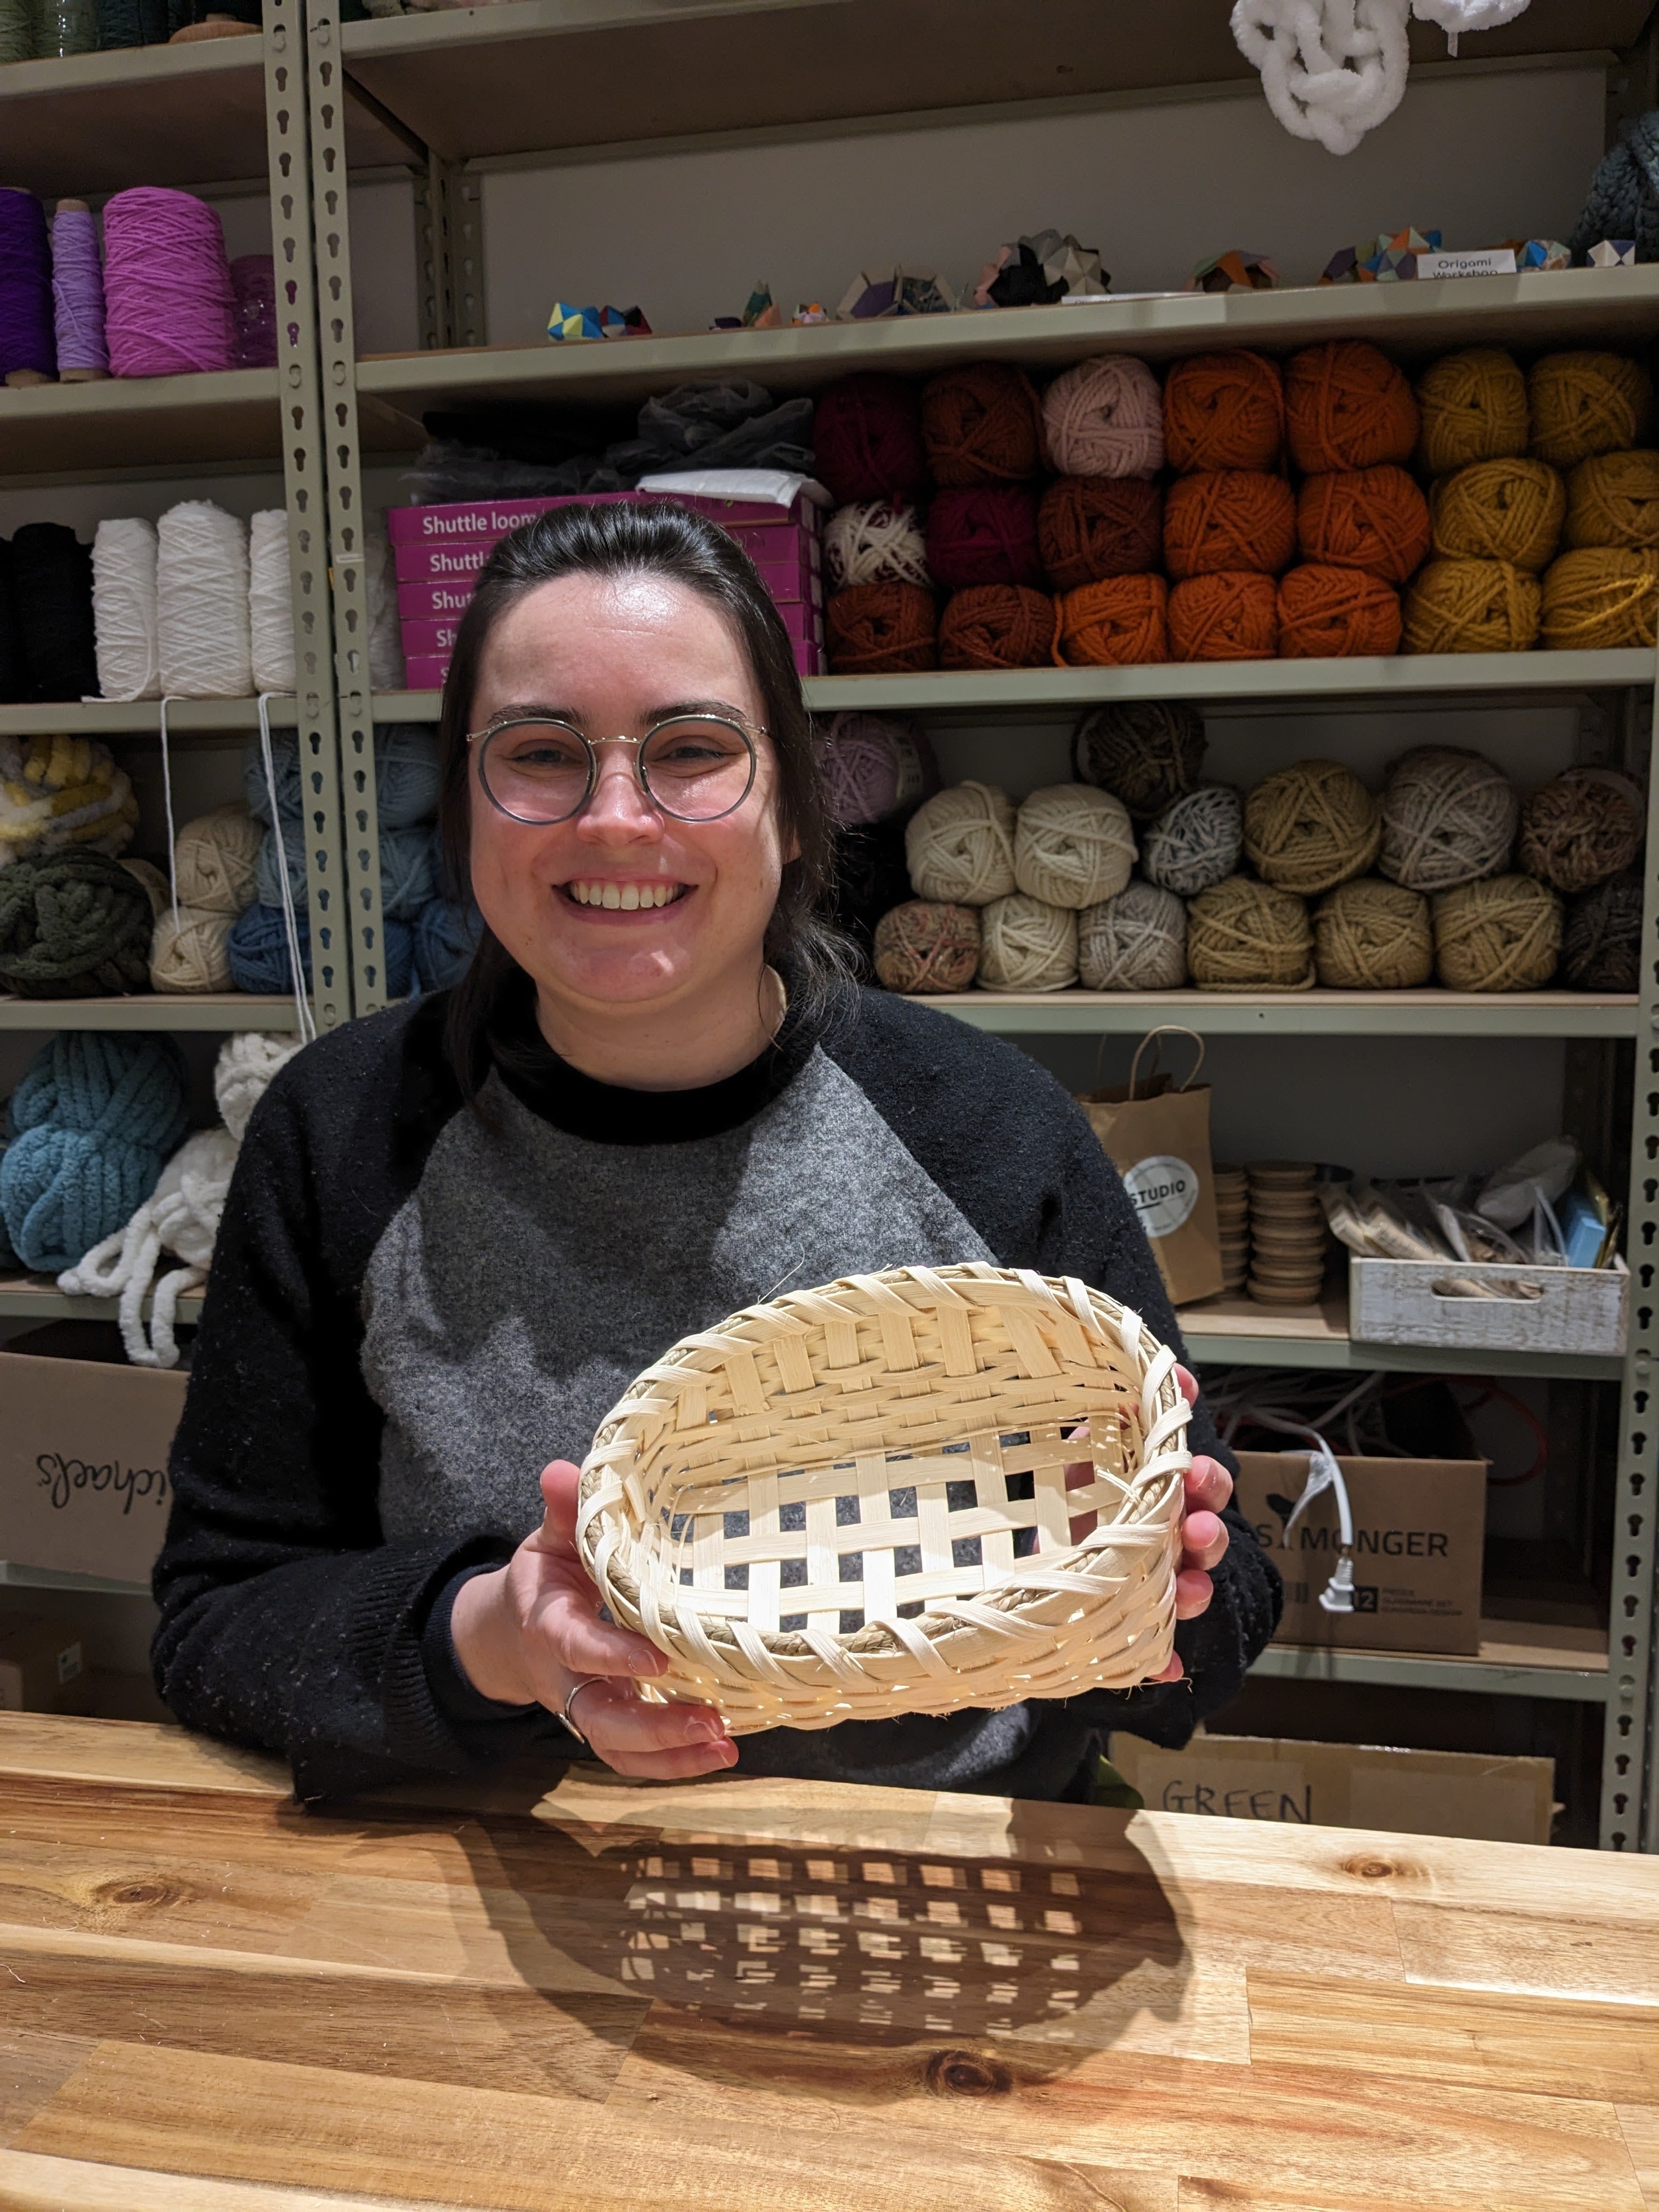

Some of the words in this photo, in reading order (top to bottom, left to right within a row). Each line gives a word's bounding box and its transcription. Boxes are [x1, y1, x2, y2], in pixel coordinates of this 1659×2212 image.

[1438, 258, 1491, 269] Origami
[422, 514, 487, 535] Shuttle
[430, 551, 490, 572] Shuttl
[1130, 1180, 1186, 1205] STUDIO
[36, 1453, 166, 1515] ichaels
[1162, 1780, 1312, 1824] GREEN
